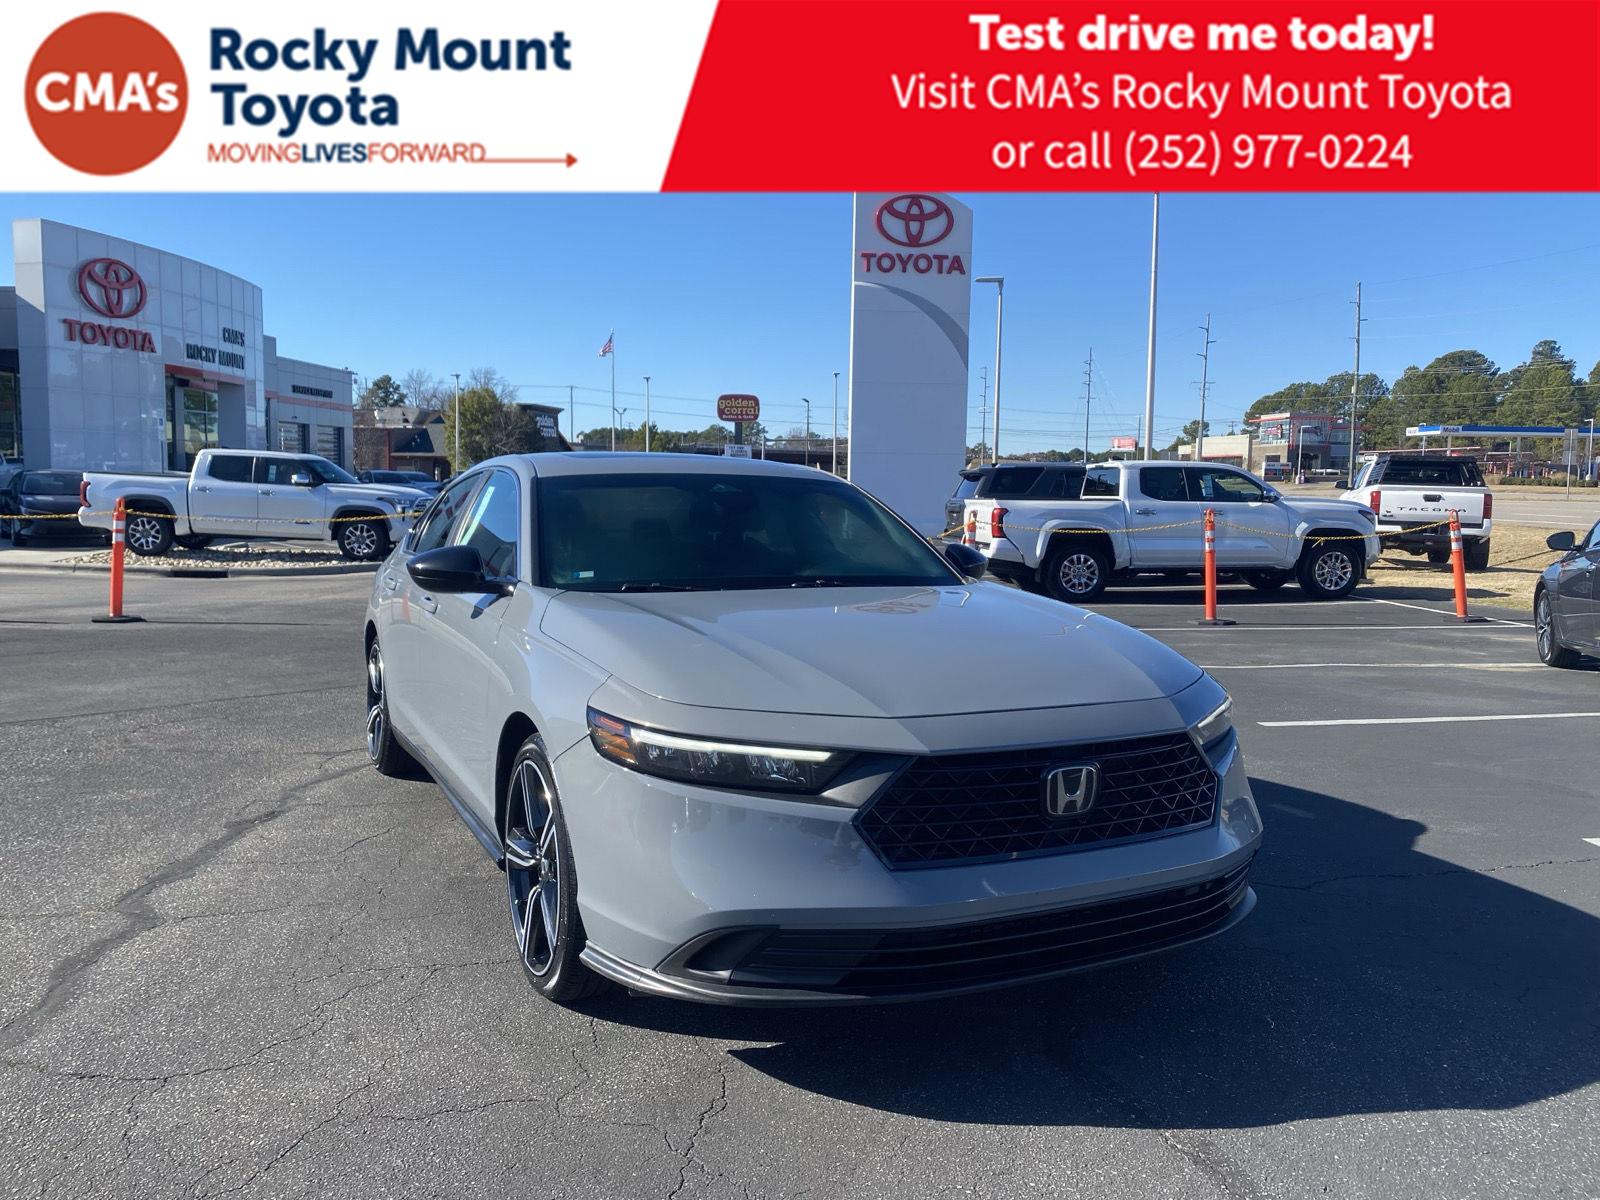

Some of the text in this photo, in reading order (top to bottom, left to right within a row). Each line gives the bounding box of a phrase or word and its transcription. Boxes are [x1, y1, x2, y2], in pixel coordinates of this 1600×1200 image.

[861, 252, 965, 275] TOYOTA
[63, 318, 157, 353] TOYOTA
[186, 343, 245, 370] ROCKY MOUNT
[719, 398, 754, 408] golden
[725, 406, 758, 414] corral
